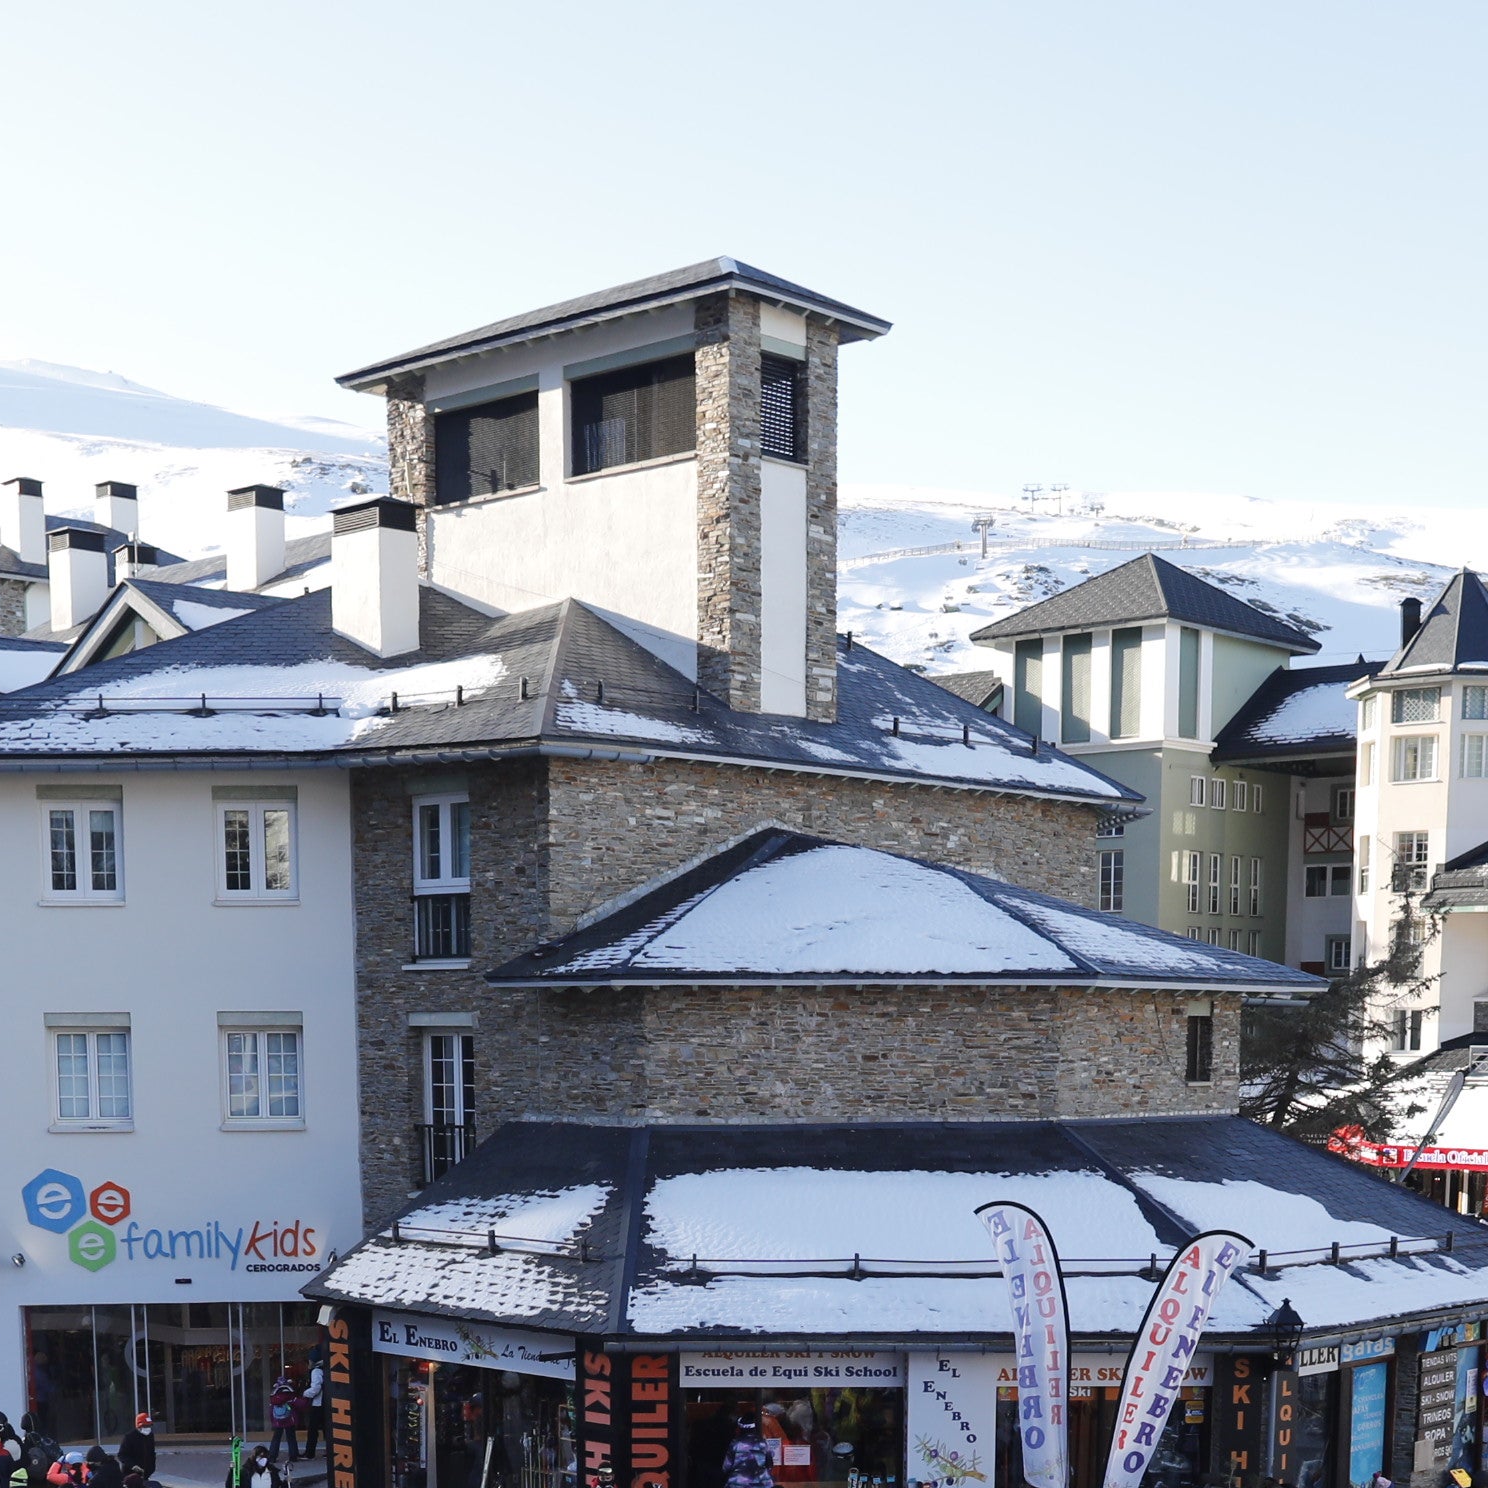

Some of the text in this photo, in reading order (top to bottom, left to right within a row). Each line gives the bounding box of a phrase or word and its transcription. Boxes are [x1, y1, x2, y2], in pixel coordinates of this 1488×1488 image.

[245, 1263, 321, 1272] CEROGRADOS
[328, 1317, 351, 1384] SKI
[684, 1365, 898, 1380] Escuela de Equi Ski School
[1423, 1370, 1455, 1387] ALQUILER
[584, 1350, 611, 1426] SKI
[923, 1380, 977, 1444] ENEBRO
[1122, 1304, 1205, 1474] ENEBRO
[1232, 1357, 1251, 1430] SKI
[1423, 1407, 1452, 1425] TRINEOS
